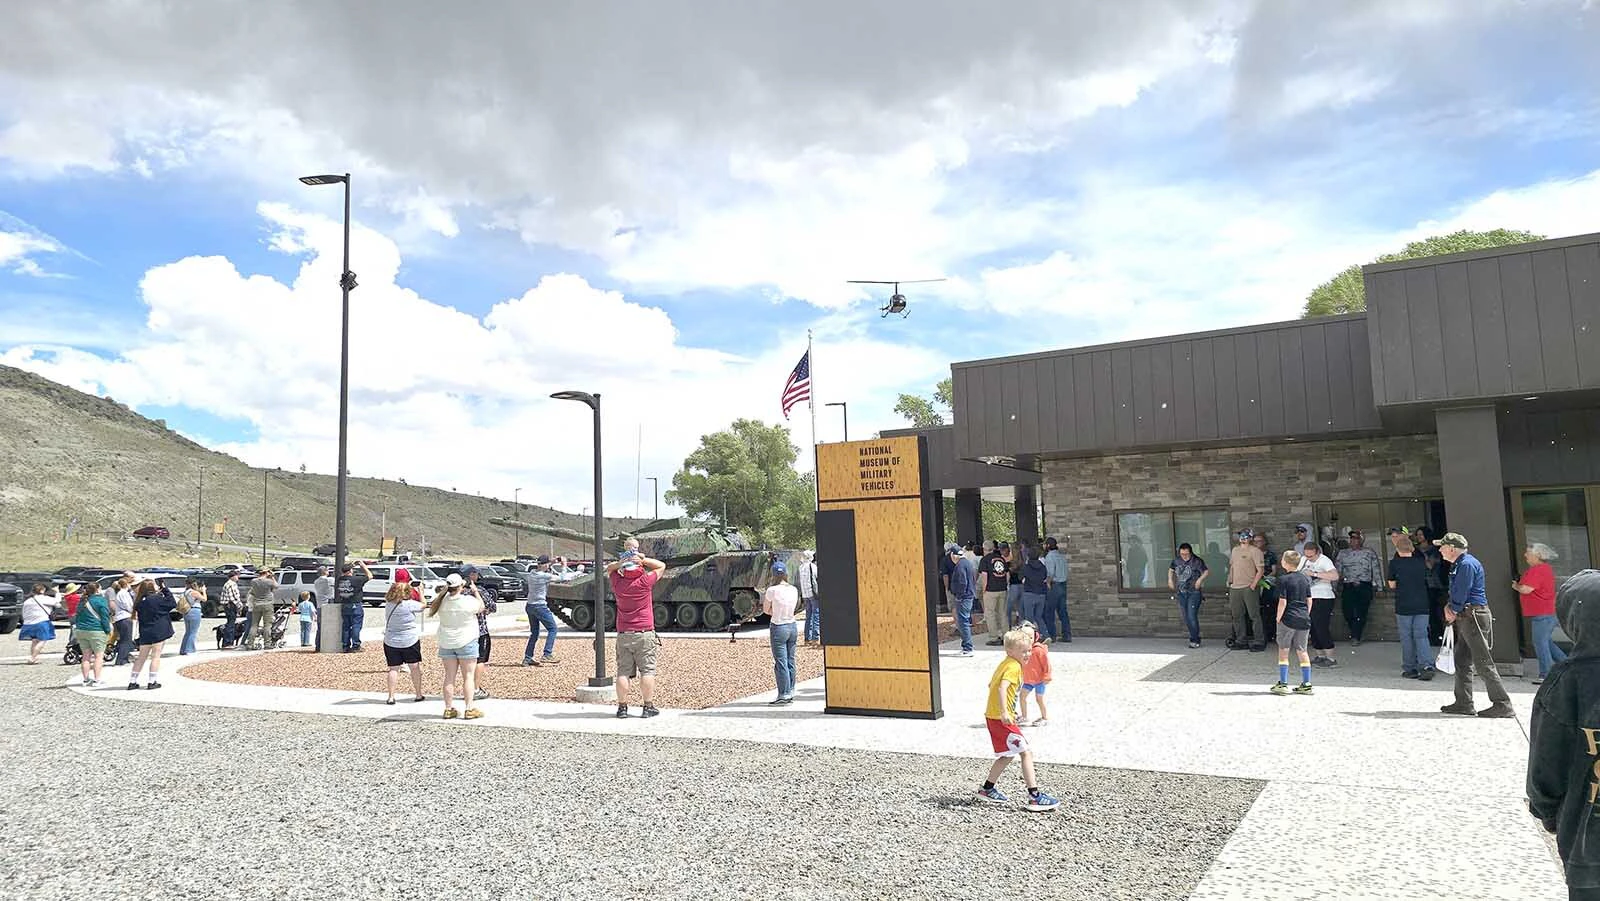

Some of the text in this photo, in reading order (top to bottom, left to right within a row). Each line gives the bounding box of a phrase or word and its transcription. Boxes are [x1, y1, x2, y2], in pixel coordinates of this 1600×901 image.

[859, 445, 892, 456] NATIONAL
[859, 456, 901, 467] MUSEUM OF
[860, 469, 892, 479] MILITARY
[860, 480, 895, 491] VEHICLES
